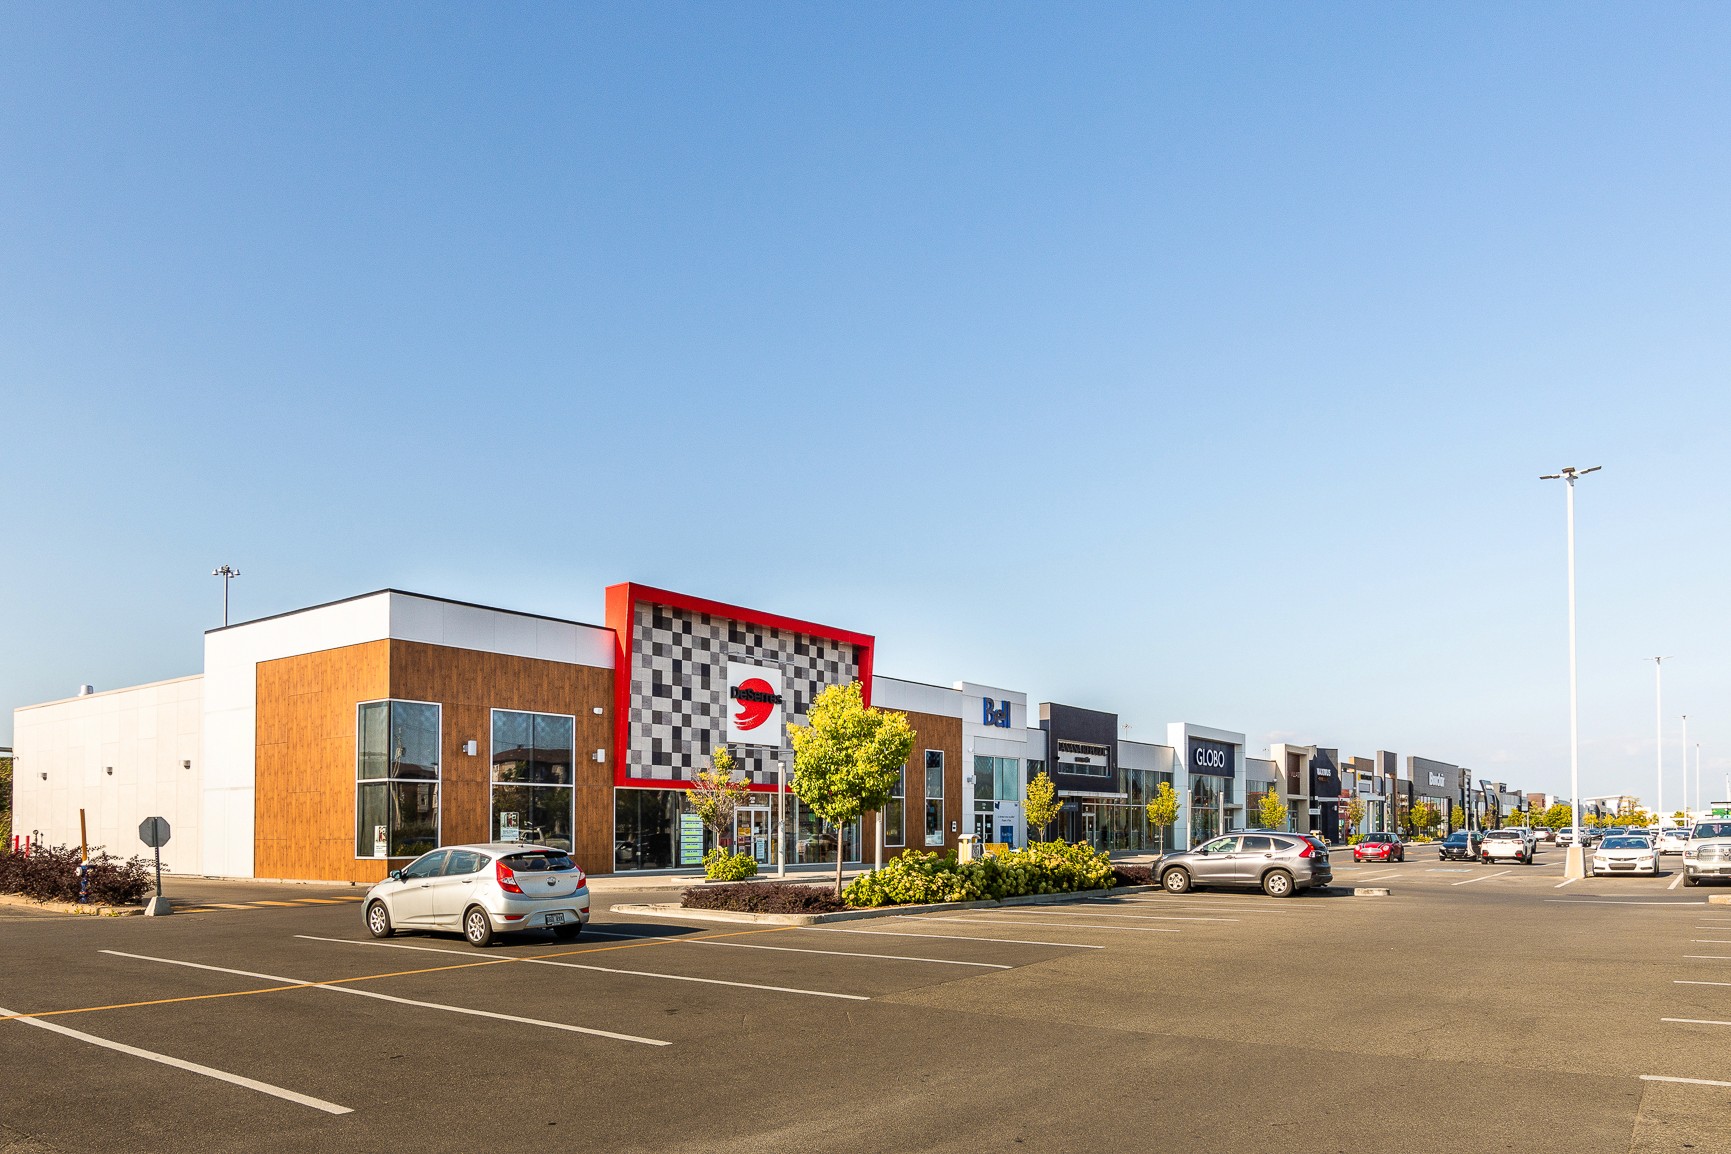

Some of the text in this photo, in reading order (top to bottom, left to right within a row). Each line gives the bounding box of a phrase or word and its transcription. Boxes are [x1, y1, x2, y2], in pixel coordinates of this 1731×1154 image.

[730, 686, 782, 705] DeSerres
[983, 697, 1011, 728] Bell
[1196, 747, 1225, 768] GLOBO
